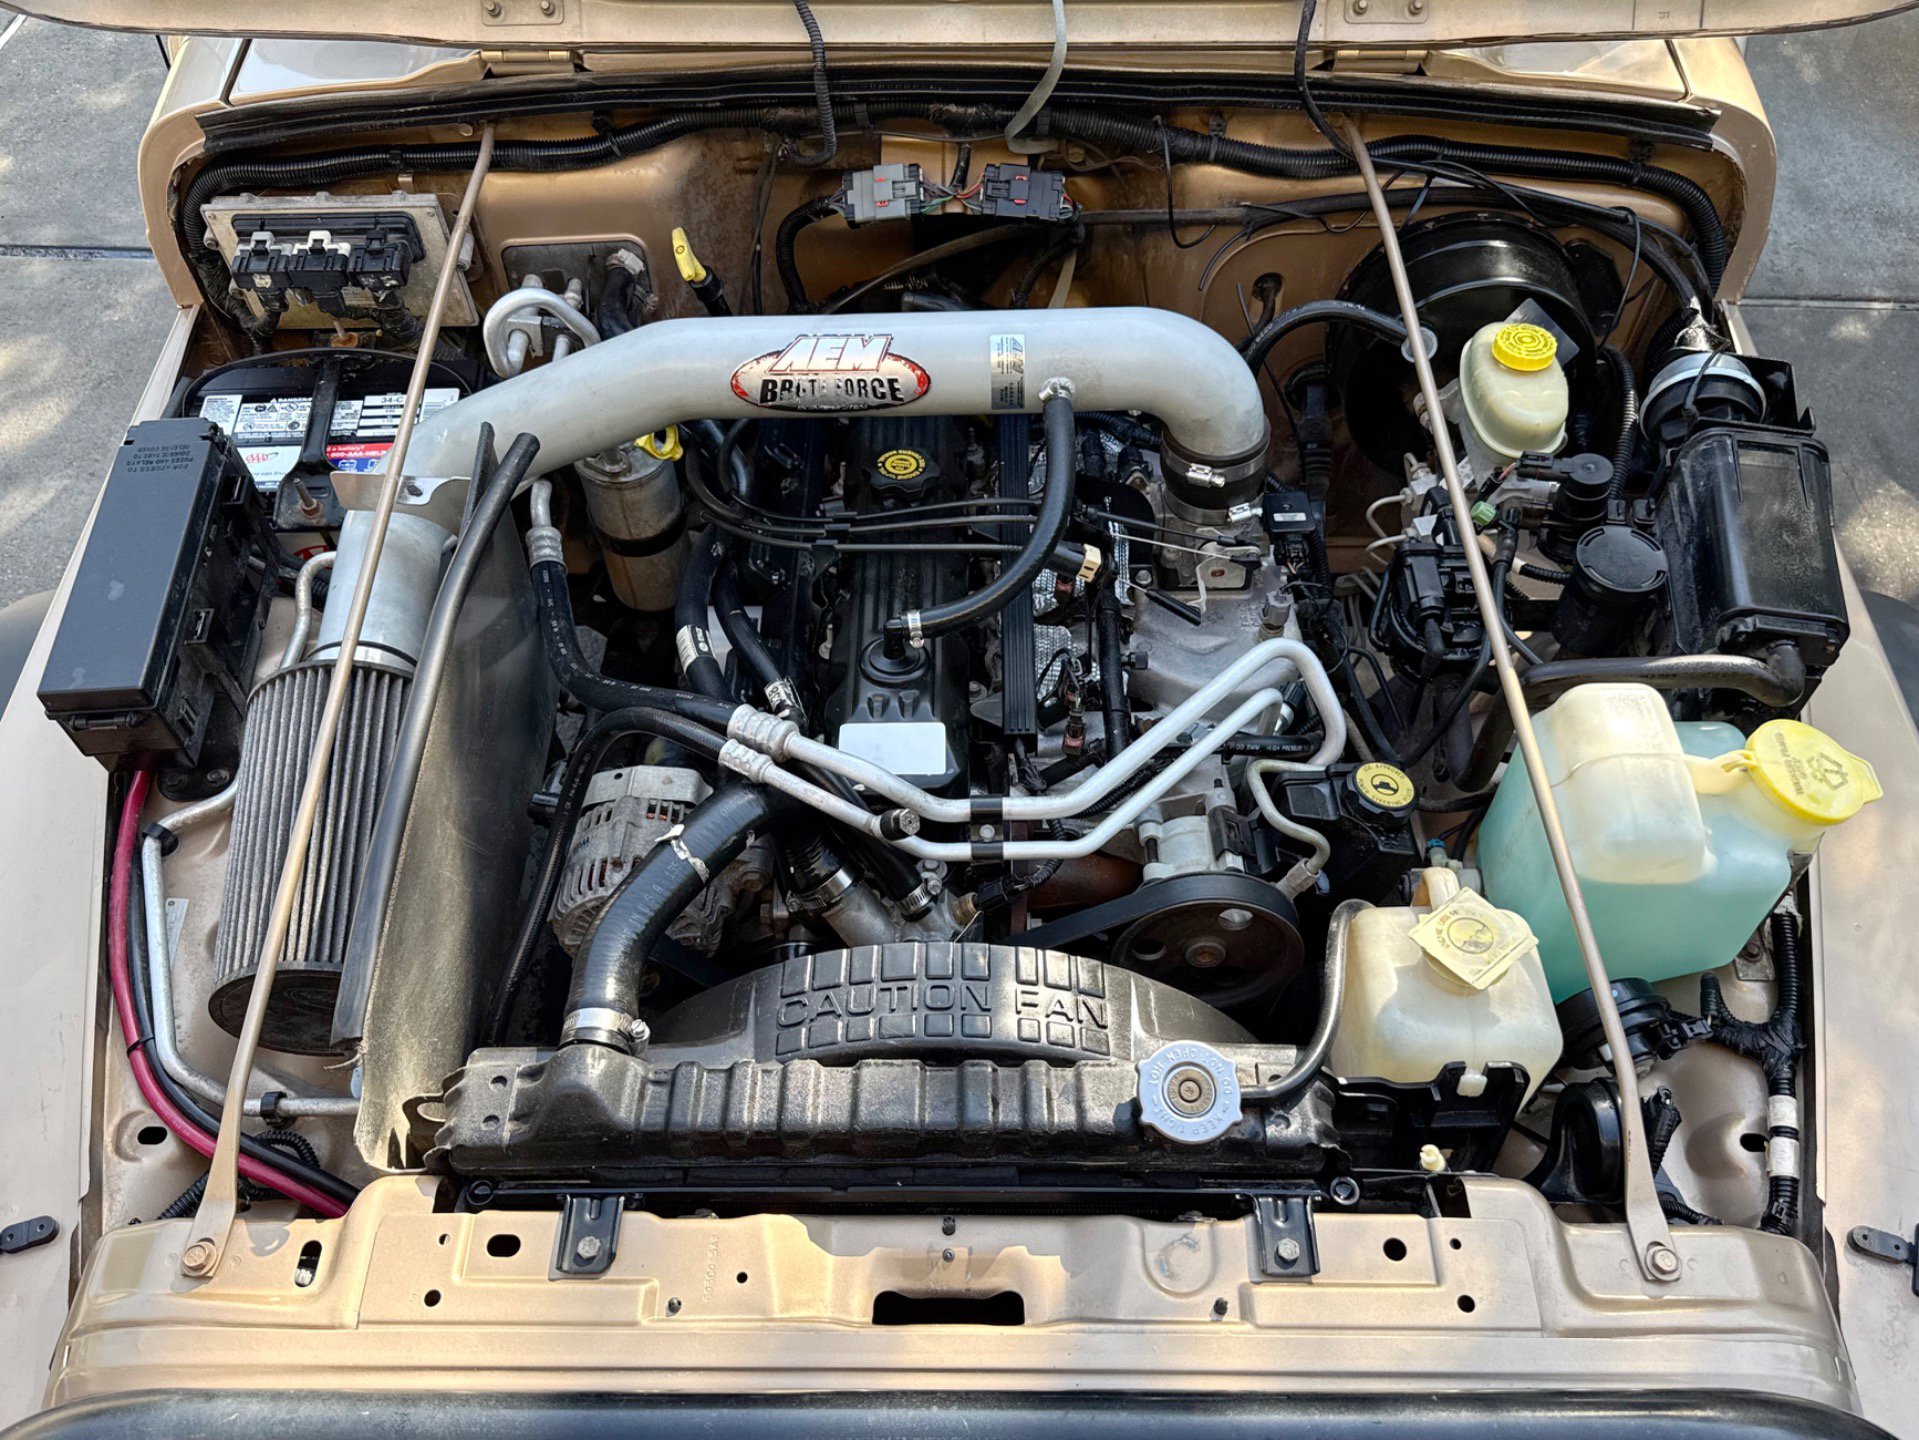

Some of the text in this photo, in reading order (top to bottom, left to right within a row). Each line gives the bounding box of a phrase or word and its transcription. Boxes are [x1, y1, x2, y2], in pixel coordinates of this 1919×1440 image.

[766, 334, 893, 374] AEM
[140, 465, 171, 473] ACCESS
[776, 983, 1109, 1030] CAUTION FAN
[1165, 1047, 1198, 1062] OPEN
[1147, 1060, 1165, 1086] HOT
[1192, 1113, 1224, 1136] KEEP
